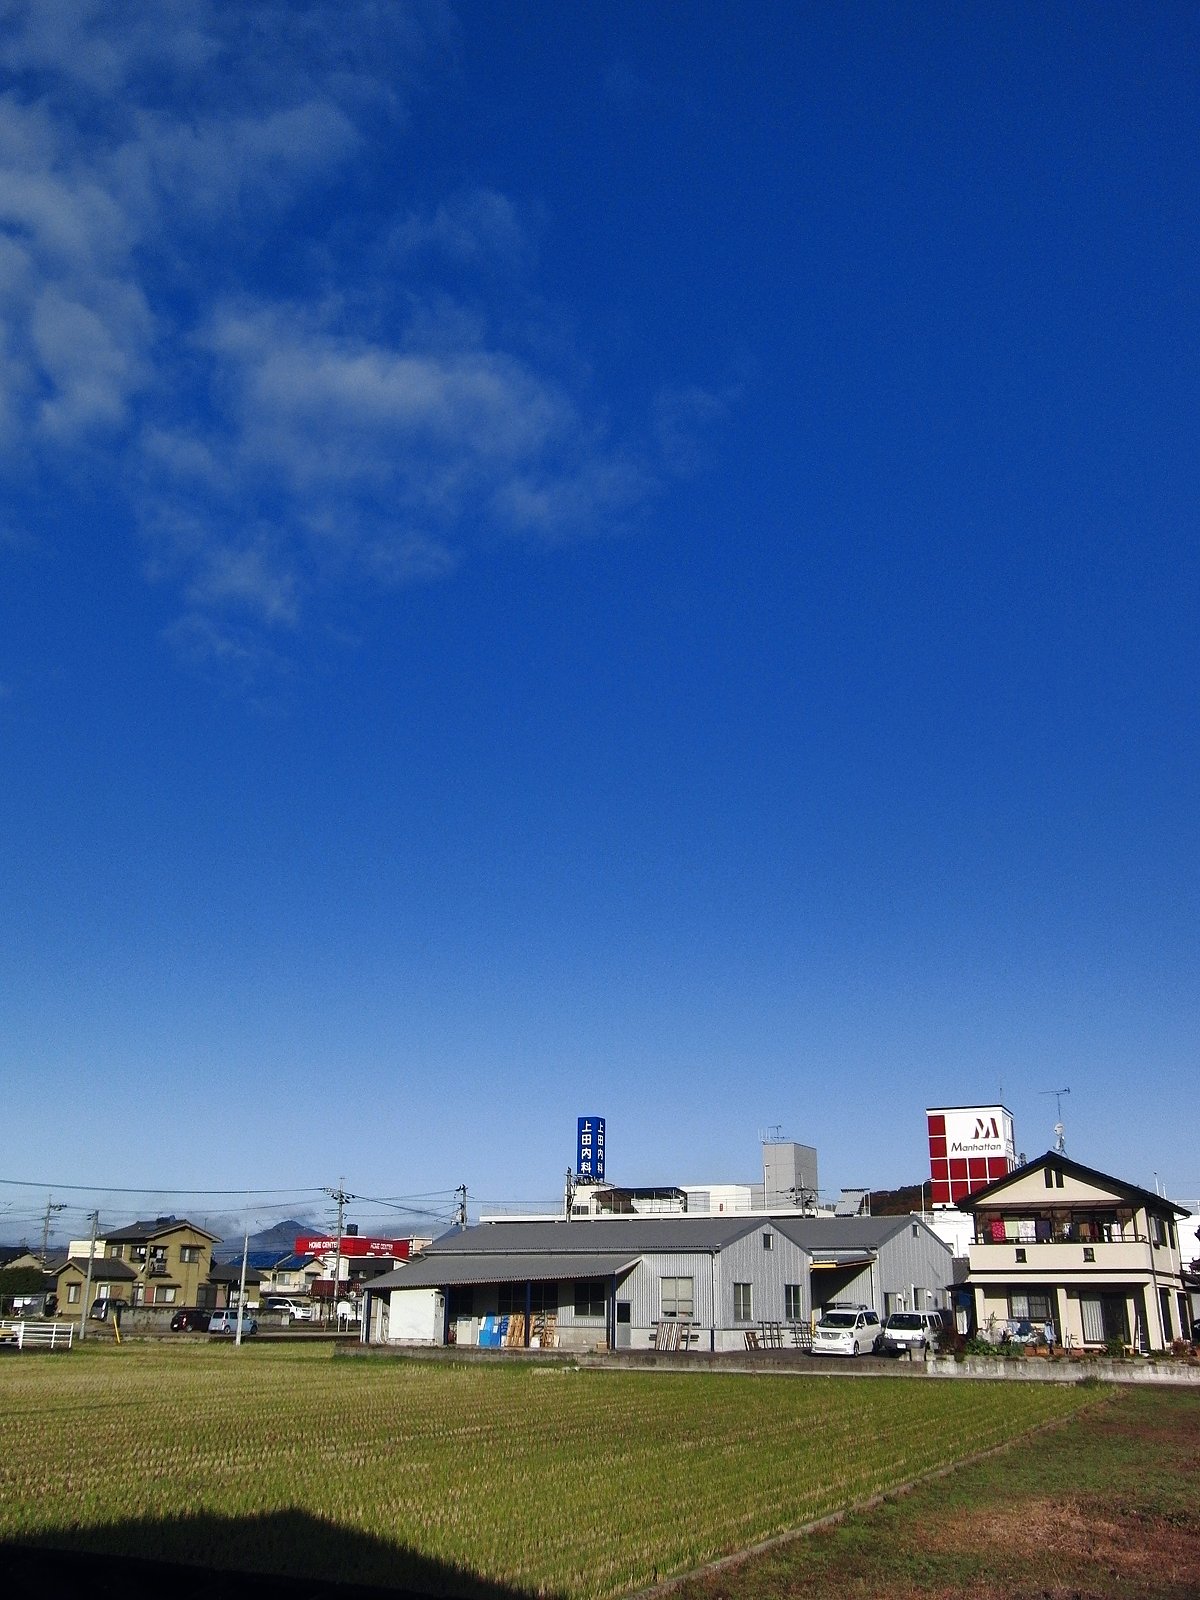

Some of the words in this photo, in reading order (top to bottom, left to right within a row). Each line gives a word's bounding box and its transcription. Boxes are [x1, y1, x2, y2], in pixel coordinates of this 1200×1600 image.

[580, 1120, 592, 1174] 上田内科
[951, 1142, 1002, 1152] Manhattan
[308, 1241, 322, 1249] HOME
[322, 1241, 338, 1249] CENTE
